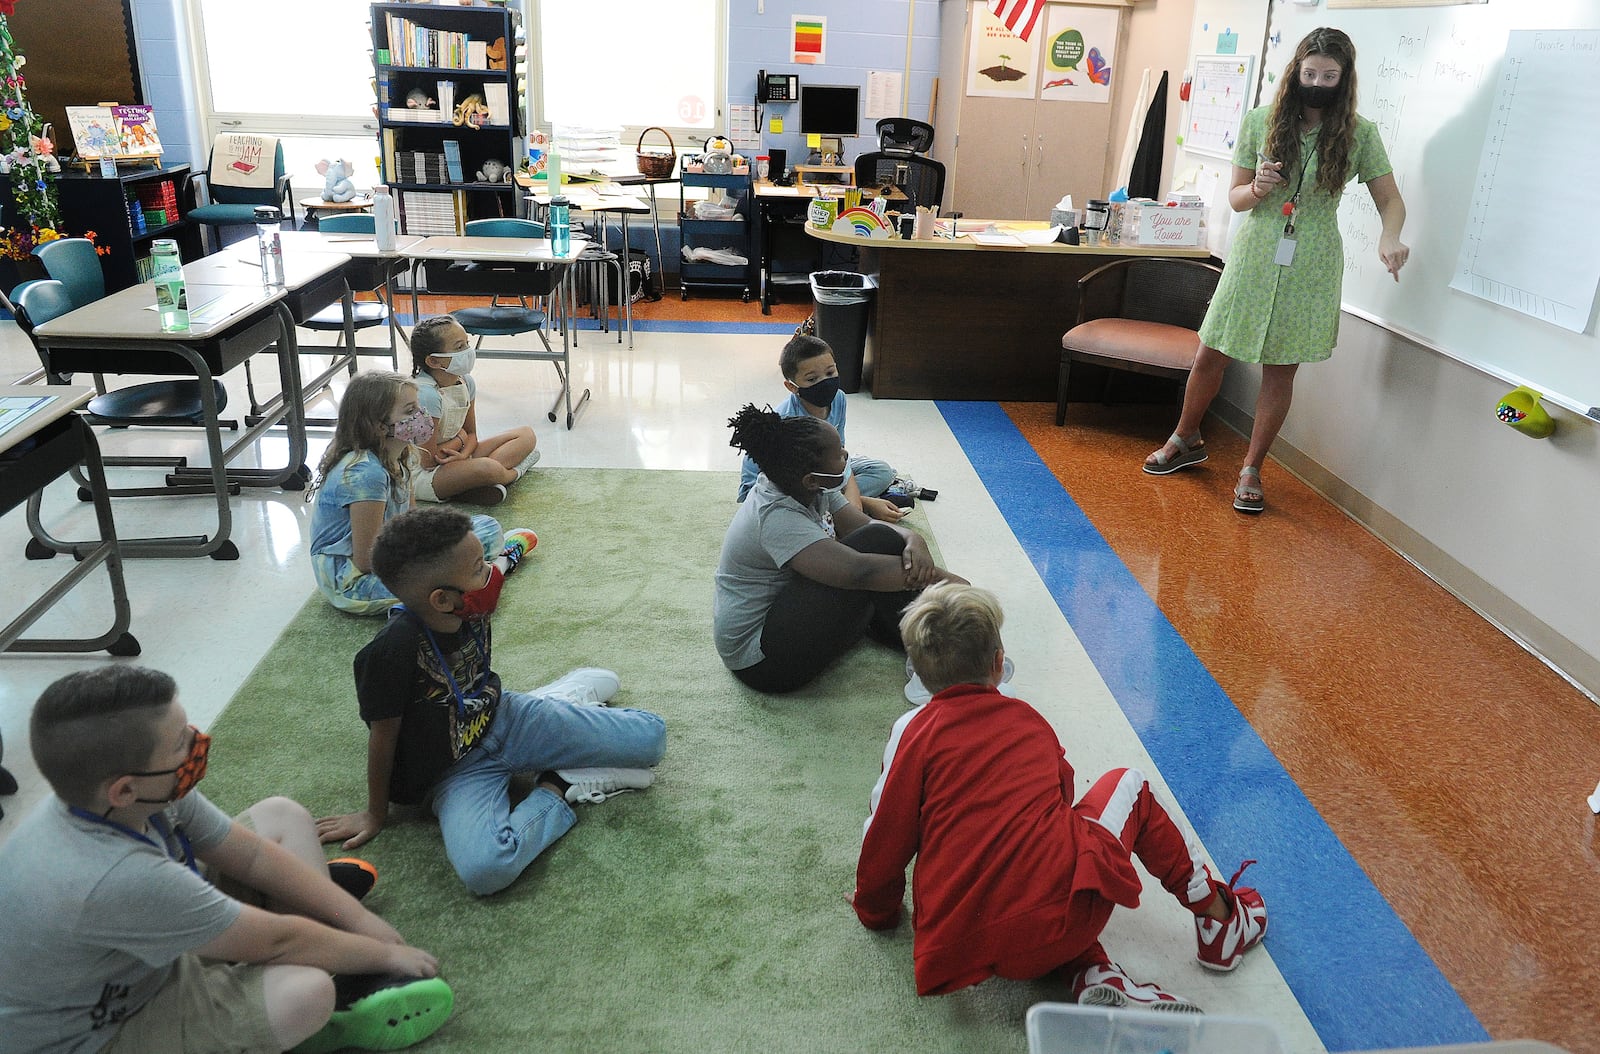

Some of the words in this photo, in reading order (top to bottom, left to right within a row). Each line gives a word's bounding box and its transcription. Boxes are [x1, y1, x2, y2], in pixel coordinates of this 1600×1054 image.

[229, 135, 263, 146] TEACHING
[240, 144, 262, 164] JAM
[1150, 212, 1172, 229] You
[1174, 216, 1192, 226] are
[1154, 228, 1183, 243] Loved
